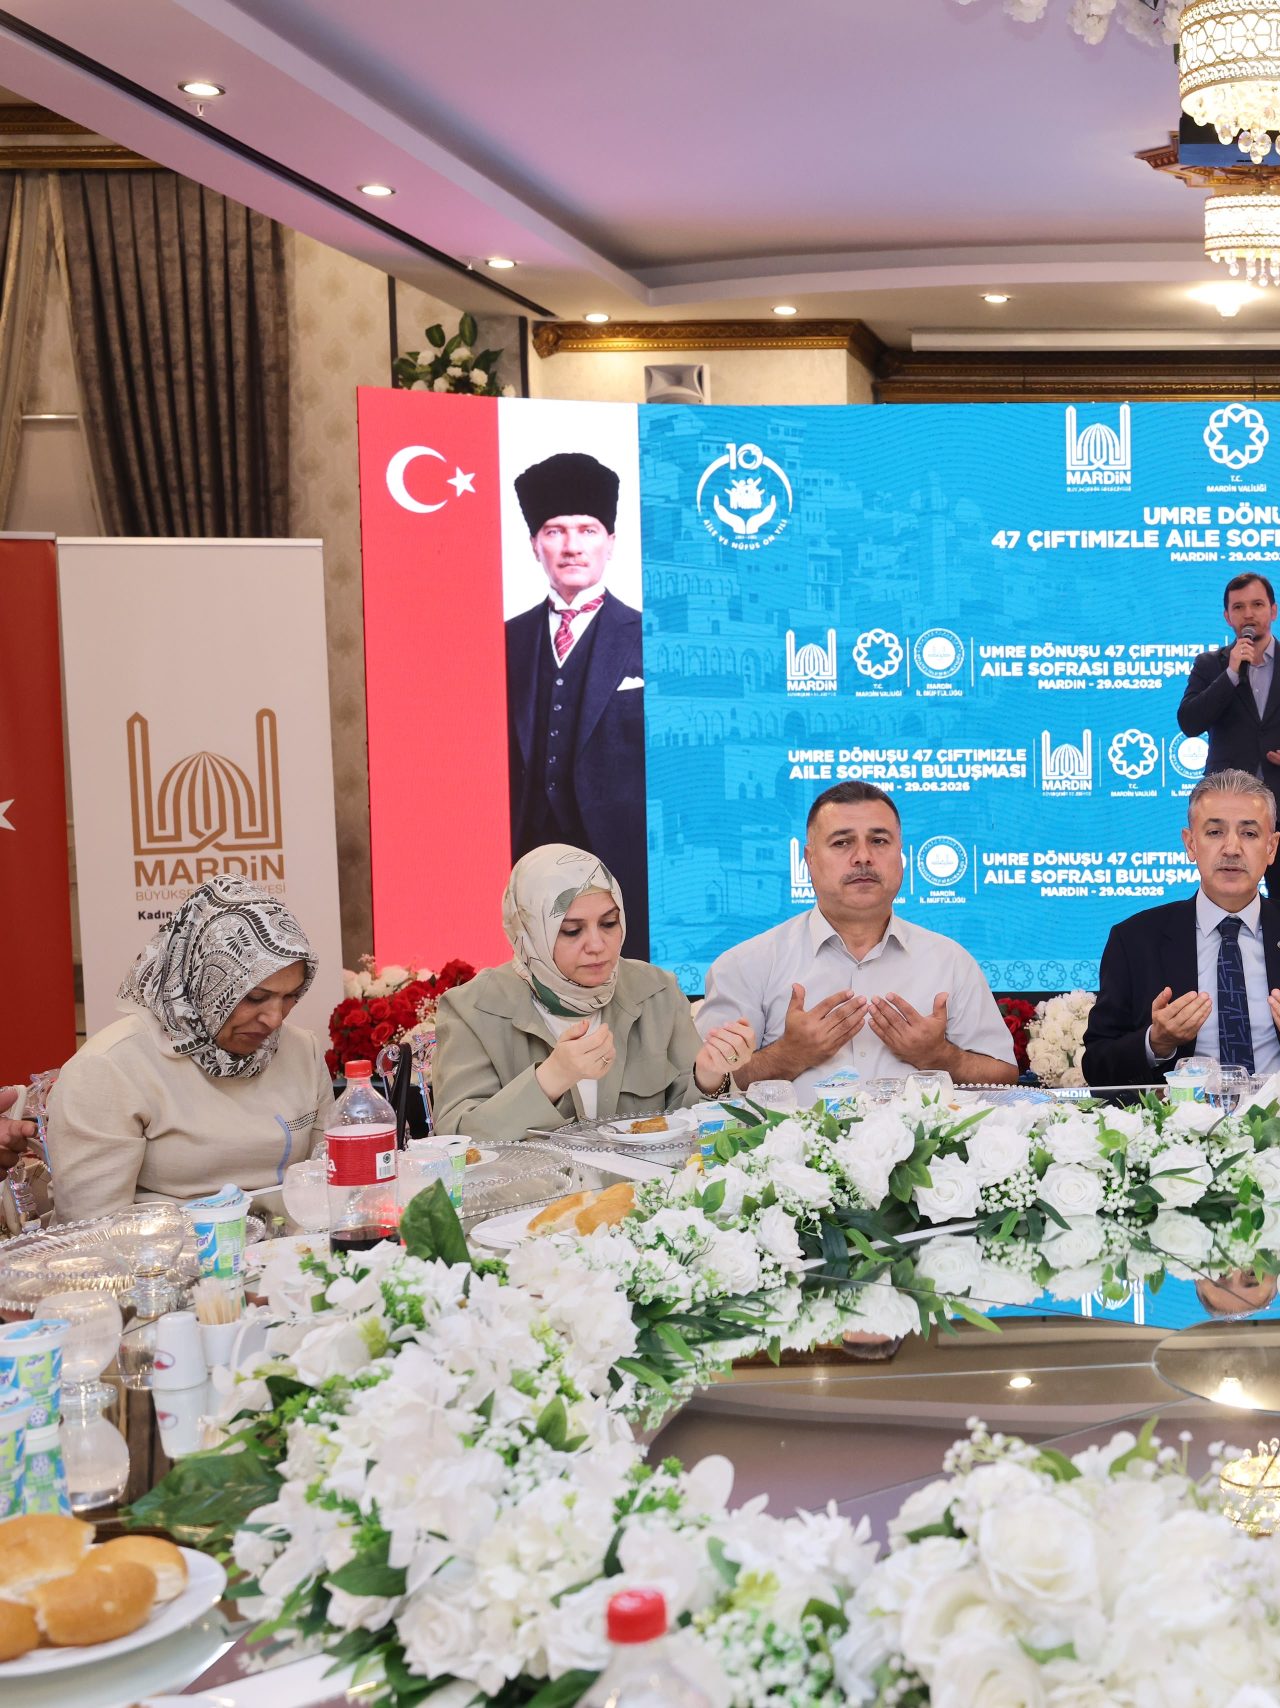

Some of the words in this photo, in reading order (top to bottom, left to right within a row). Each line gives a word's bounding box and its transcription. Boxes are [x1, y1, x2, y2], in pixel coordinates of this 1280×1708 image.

[726, 443, 763, 470] 10
[1207, 484, 1236, 492] MARDİN
[1144, 507, 1211, 524] UMRE
[718, 535, 728, 546] VE
[763, 535, 775, 546] ON
[991, 530, 1021, 549] 47
[980, 646, 1026, 658] UMRE
[1105, 645, 1123, 658] 47
[1028, 662, 1109, 676] SOFRASI
[1097, 679, 1162, 689] 29.06.2026
[788, 750, 834, 762] UMRE
[912, 749, 934, 762] 47
[836, 765, 916, 779] SOFRASI
[922, 764, 1026, 781] BULUŞMASI
[905, 782, 970, 791] 29.06.2026
[983, 853, 1029, 866] UMRE
[1107, 853, 1126, 865] 47
[1031, 870, 1111, 883] SOFRASI
[1116, 869, 1201, 885] BULUŞMA
[1099, 887, 1164, 896] 29.06.2026
